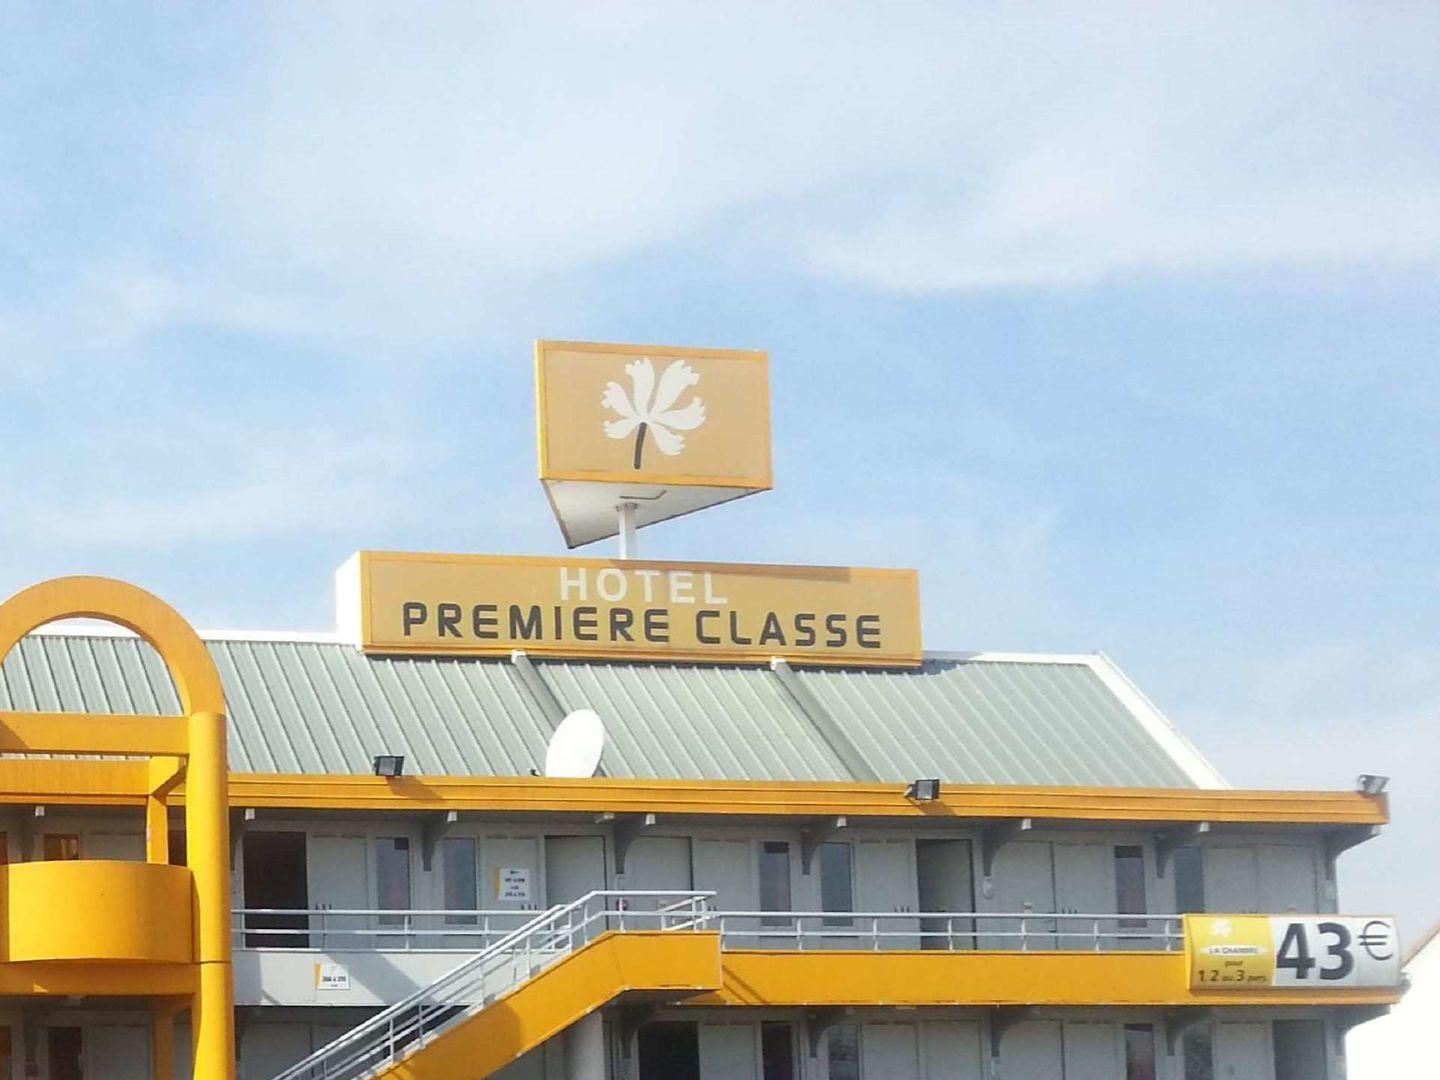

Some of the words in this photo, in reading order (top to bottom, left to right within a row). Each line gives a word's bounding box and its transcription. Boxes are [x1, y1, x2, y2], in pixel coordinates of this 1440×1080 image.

[558, 566, 729, 605] HOTEL
[402, 601, 669, 643] PREMIERE
[695, 608, 882, 649] CLASSE
[1275, 920, 1394, 981] 43€
[1236, 969, 1245, 982] 3
